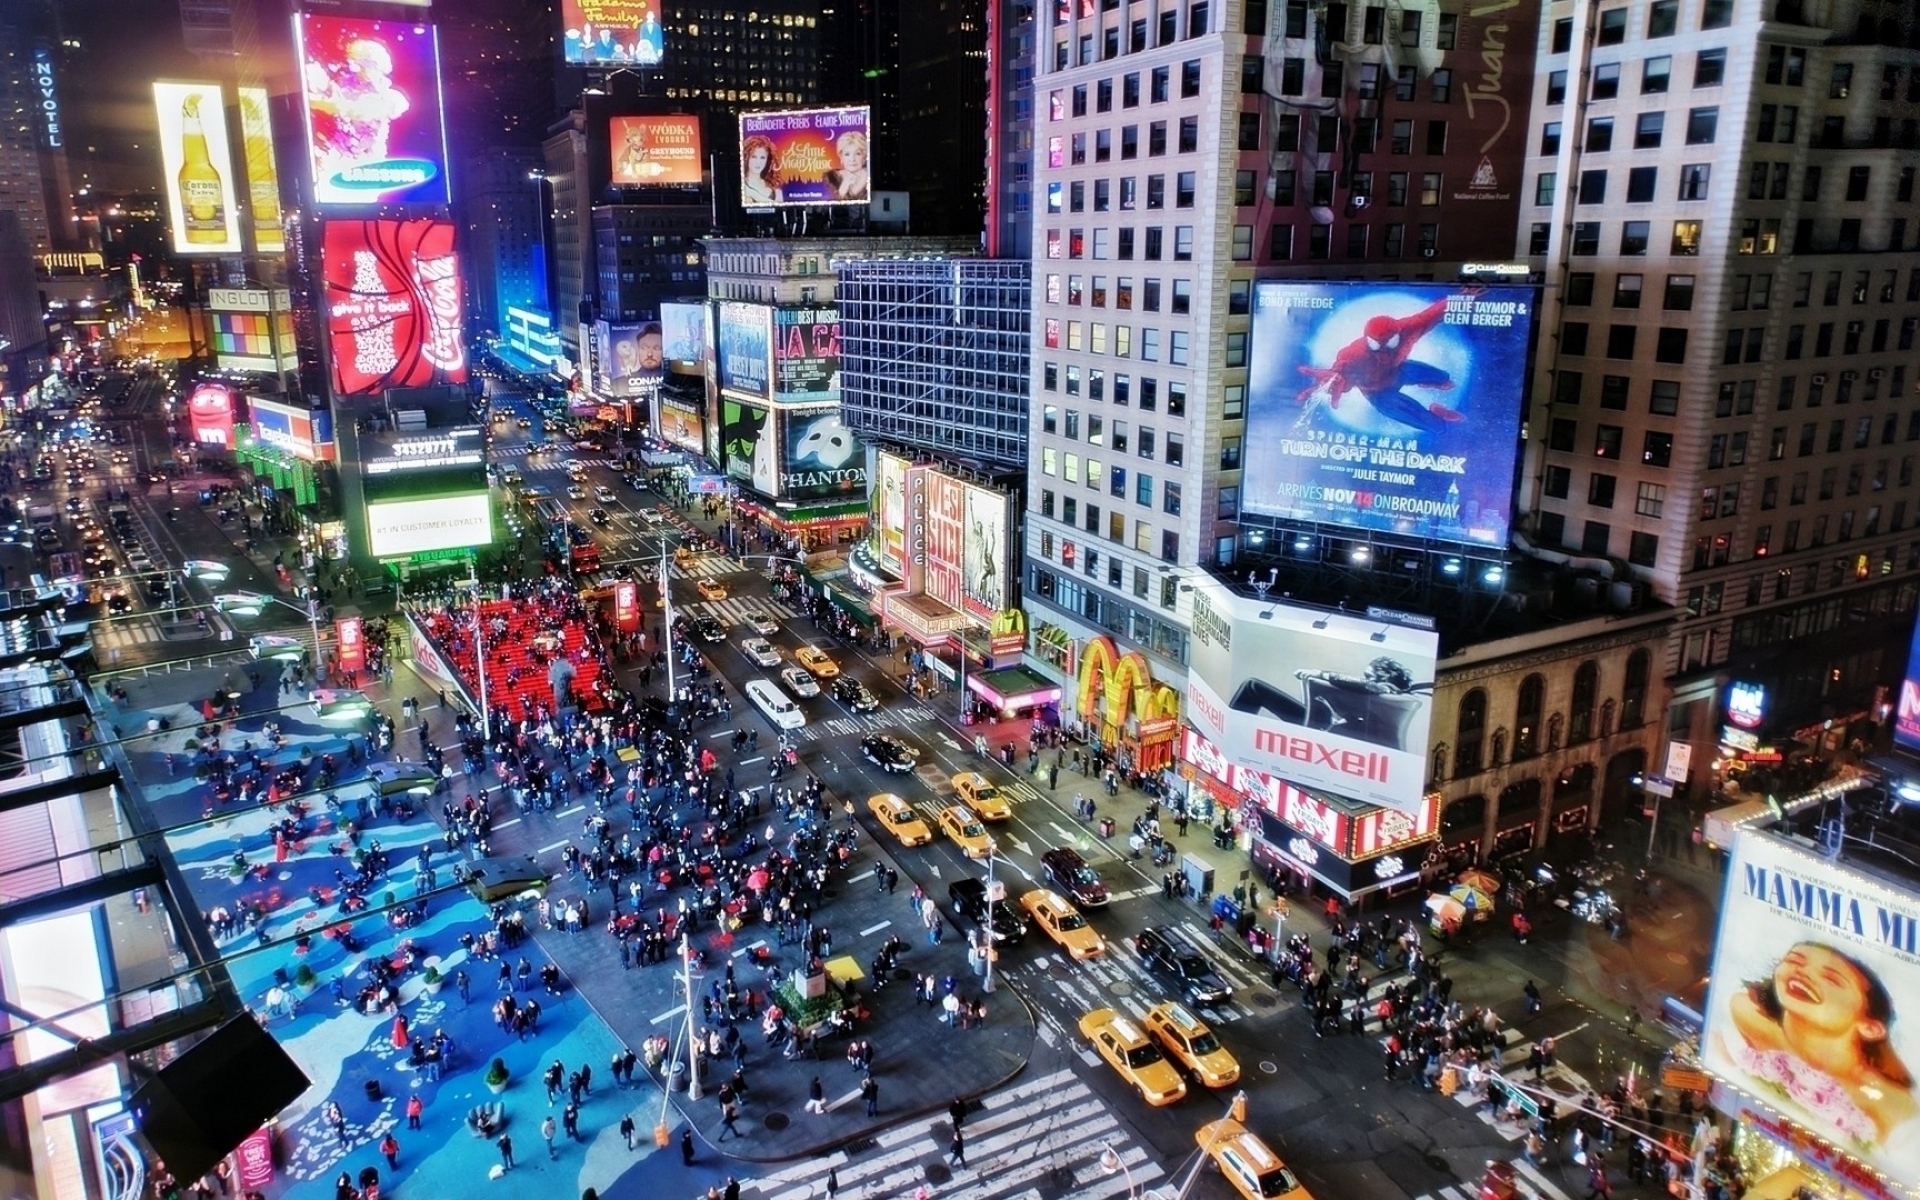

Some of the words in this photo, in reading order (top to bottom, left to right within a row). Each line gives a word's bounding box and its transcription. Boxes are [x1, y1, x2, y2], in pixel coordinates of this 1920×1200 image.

[584, 8, 643, 29] Family
[1463, 24, 1511, 153] Juan
[37, 62, 61, 146] NOVOTEL
[649, 121, 694, 135] WÓDKA
[747, 118, 786, 131] BERNADETTE
[787, 117, 810, 129] PETERS
[815, 115, 838, 128] ELAINE
[839, 112, 864, 126] STRITCH
[649, 147, 695, 155] GREYHOUND
[182, 180, 220, 191] Corona
[210, 292, 268, 305] INGLOT
[332, 302, 361, 317] give
[364, 301, 375, 313] it
[378, 300, 410, 312] back
[1259, 297, 1283, 307] BONO
[1293, 298, 1310, 308] THE
[1311, 298, 1334, 309] EDGE
[1444, 301, 1473, 313] JULIE
[1474, 302, 1516, 315] TAYMOR
[1517, 303, 1527, 315] &
[1444, 313, 1470, 325] GLEN
[1472, 314, 1512, 327] BERGER
[628, 376, 664, 387] CONAN
[791, 408, 816, 417] Tonight
[1307, 429, 1418, 451] SPIDER-MAN
[1280, 438, 1328, 459] TURN
[1329, 444, 1368, 463] OFF
[1369, 448, 1405, 467] THE
[1406, 451, 1467, 474] DARK
[1352, 468, 1378, 480] JULIE
[1379, 471, 1416, 486] TAYMOR
[930, 473, 962, 522] WEST
[1277, 482, 1323, 500] ARRIVES
[1323, 487, 1357, 504] NOV
[1356, 491, 1374, 507] 14
[1373, 493, 1391, 509] ON
[1390, 497, 1460, 519] BROADWAY
[400, 519, 448, 532] CUSTOMER
[912, 477, 924, 566] PALACE
[929, 518, 962, 569] SIDE
[1193, 596, 1231, 641] MAXIMUM
[1192, 621, 1210, 648] LIVES
[1193, 611, 1231, 652] PERFORMANCE
[1189, 682, 1225, 735] maxell
[1255, 728, 1389, 783] maxell
[1297, 806, 1325, 830] FRIDAYS
[1382, 818, 1412, 835] FRIDAYS
[1800, 873, 1845, 892] ANDERSSON
[1743, 862, 1864, 937] MAMMA
[1769, 906, 1783, 916] THE
[1785, 912, 1811, 928] SMASH
[1813, 922, 1827, 932] HIT
[1829, 928, 1863, 945] MUSICAL
[1876, 906, 1920, 956] MI
